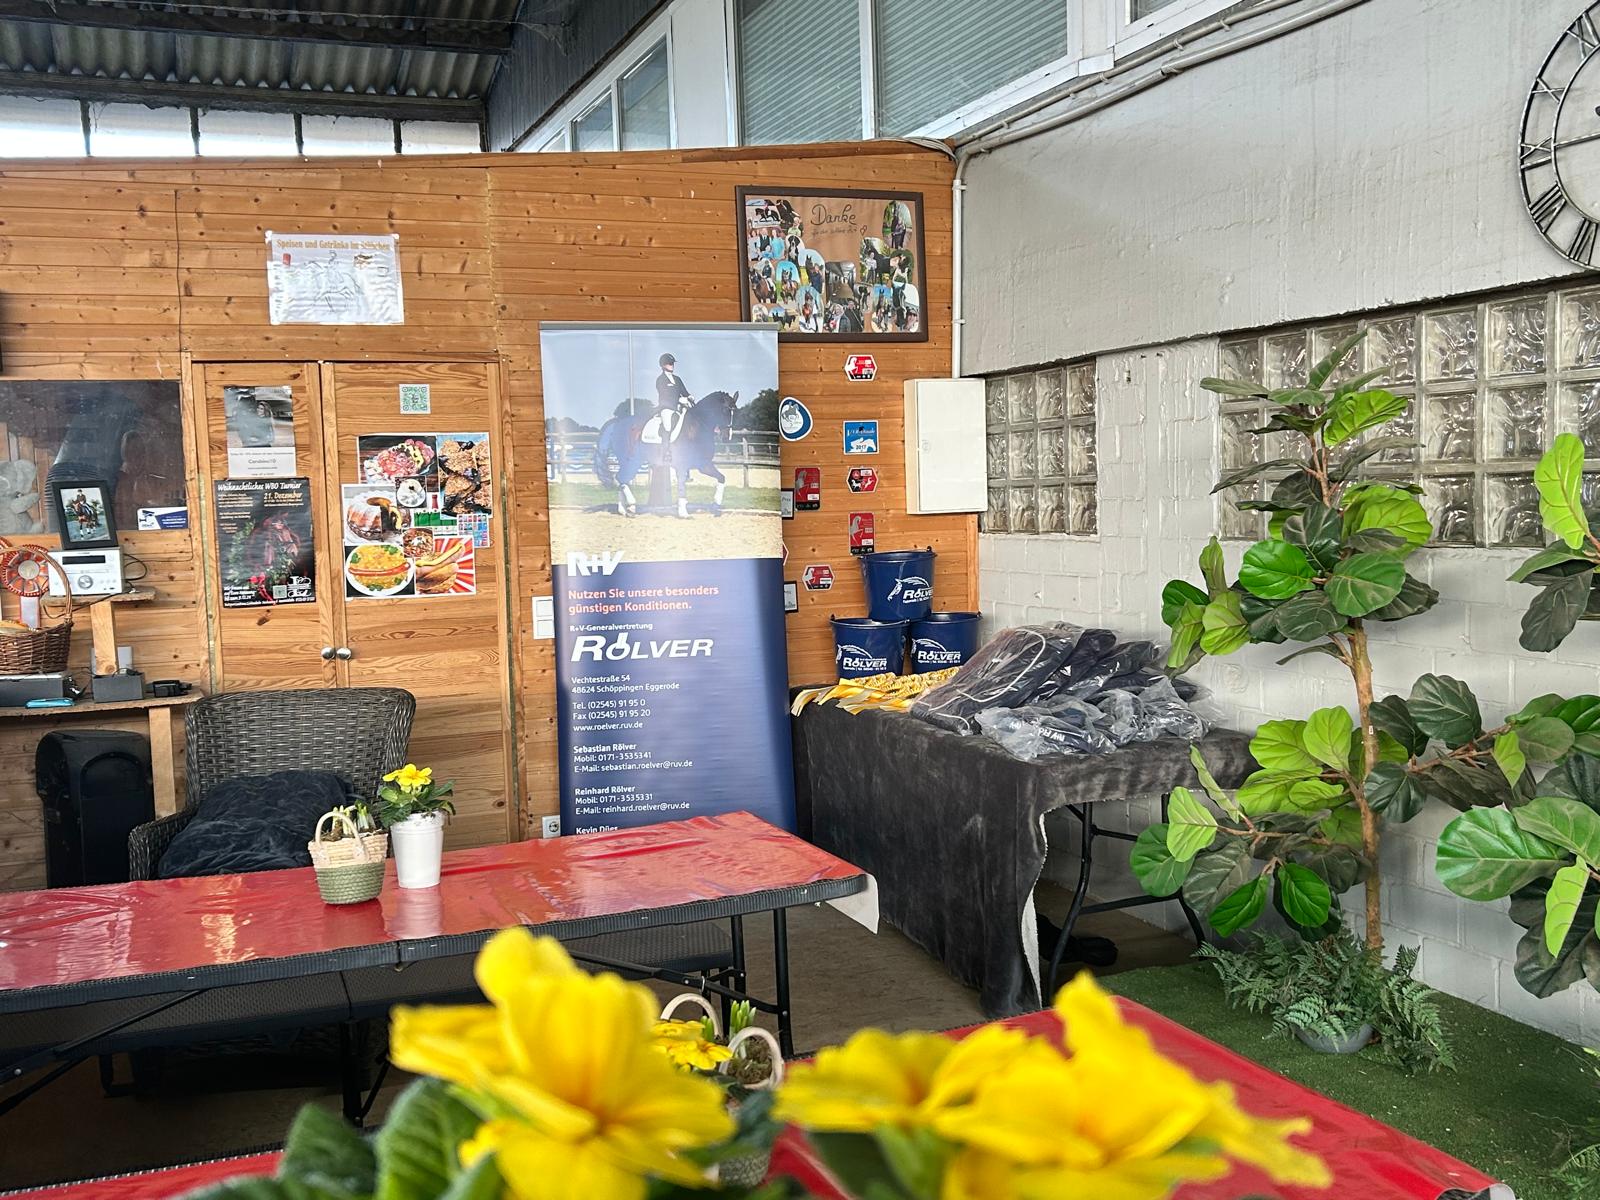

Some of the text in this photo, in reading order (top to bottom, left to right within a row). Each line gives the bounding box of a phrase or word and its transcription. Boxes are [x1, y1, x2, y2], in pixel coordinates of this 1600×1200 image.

[810, 203, 857, 226] Danke
[276, 239, 303, 250] Speisen
[304, 240, 318, 249] und
[280, 482, 302, 490] Turnier
[274, 490, 303, 499] Dezember
[566, 550, 625, 577] R+V
[568, 586, 719, 600] Nutzen Sie unsere besonders
[568, 601, 692, 615] günstigen Konditionen.
[569, 623, 653, 632] R+V-Generalvertretung
[571, 674, 631, 684] Vechtestraße 54
[571, 682, 680, 694] 48624 Schöppingen Eggerode
[572, 702, 586, 710] Tel.
[588, 700, 617, 709] (02545)
[629, 699, 639, 707] 95
[640, 698, 646, 706] 0
[572, 708, 651, 720] Fax (02545) 91 95 20
[573, 721, 643, 732] www.roelver.ruv.de
[573, 743, 637, 754] Sebastian Rölver
[573, 754, 597, 763] Mobil:
[574, 760, 693, 773] E-Mail: sebastian.roelver@ruv.de
[575, 785, 636, 795] Reinhard Rölver
[575, 796, 598, 805] Mobil:
[575, 802, 690, 815] E-Mail: reinhard.roelver@ruv.de
[575, 826, 598, 835] Kevin
